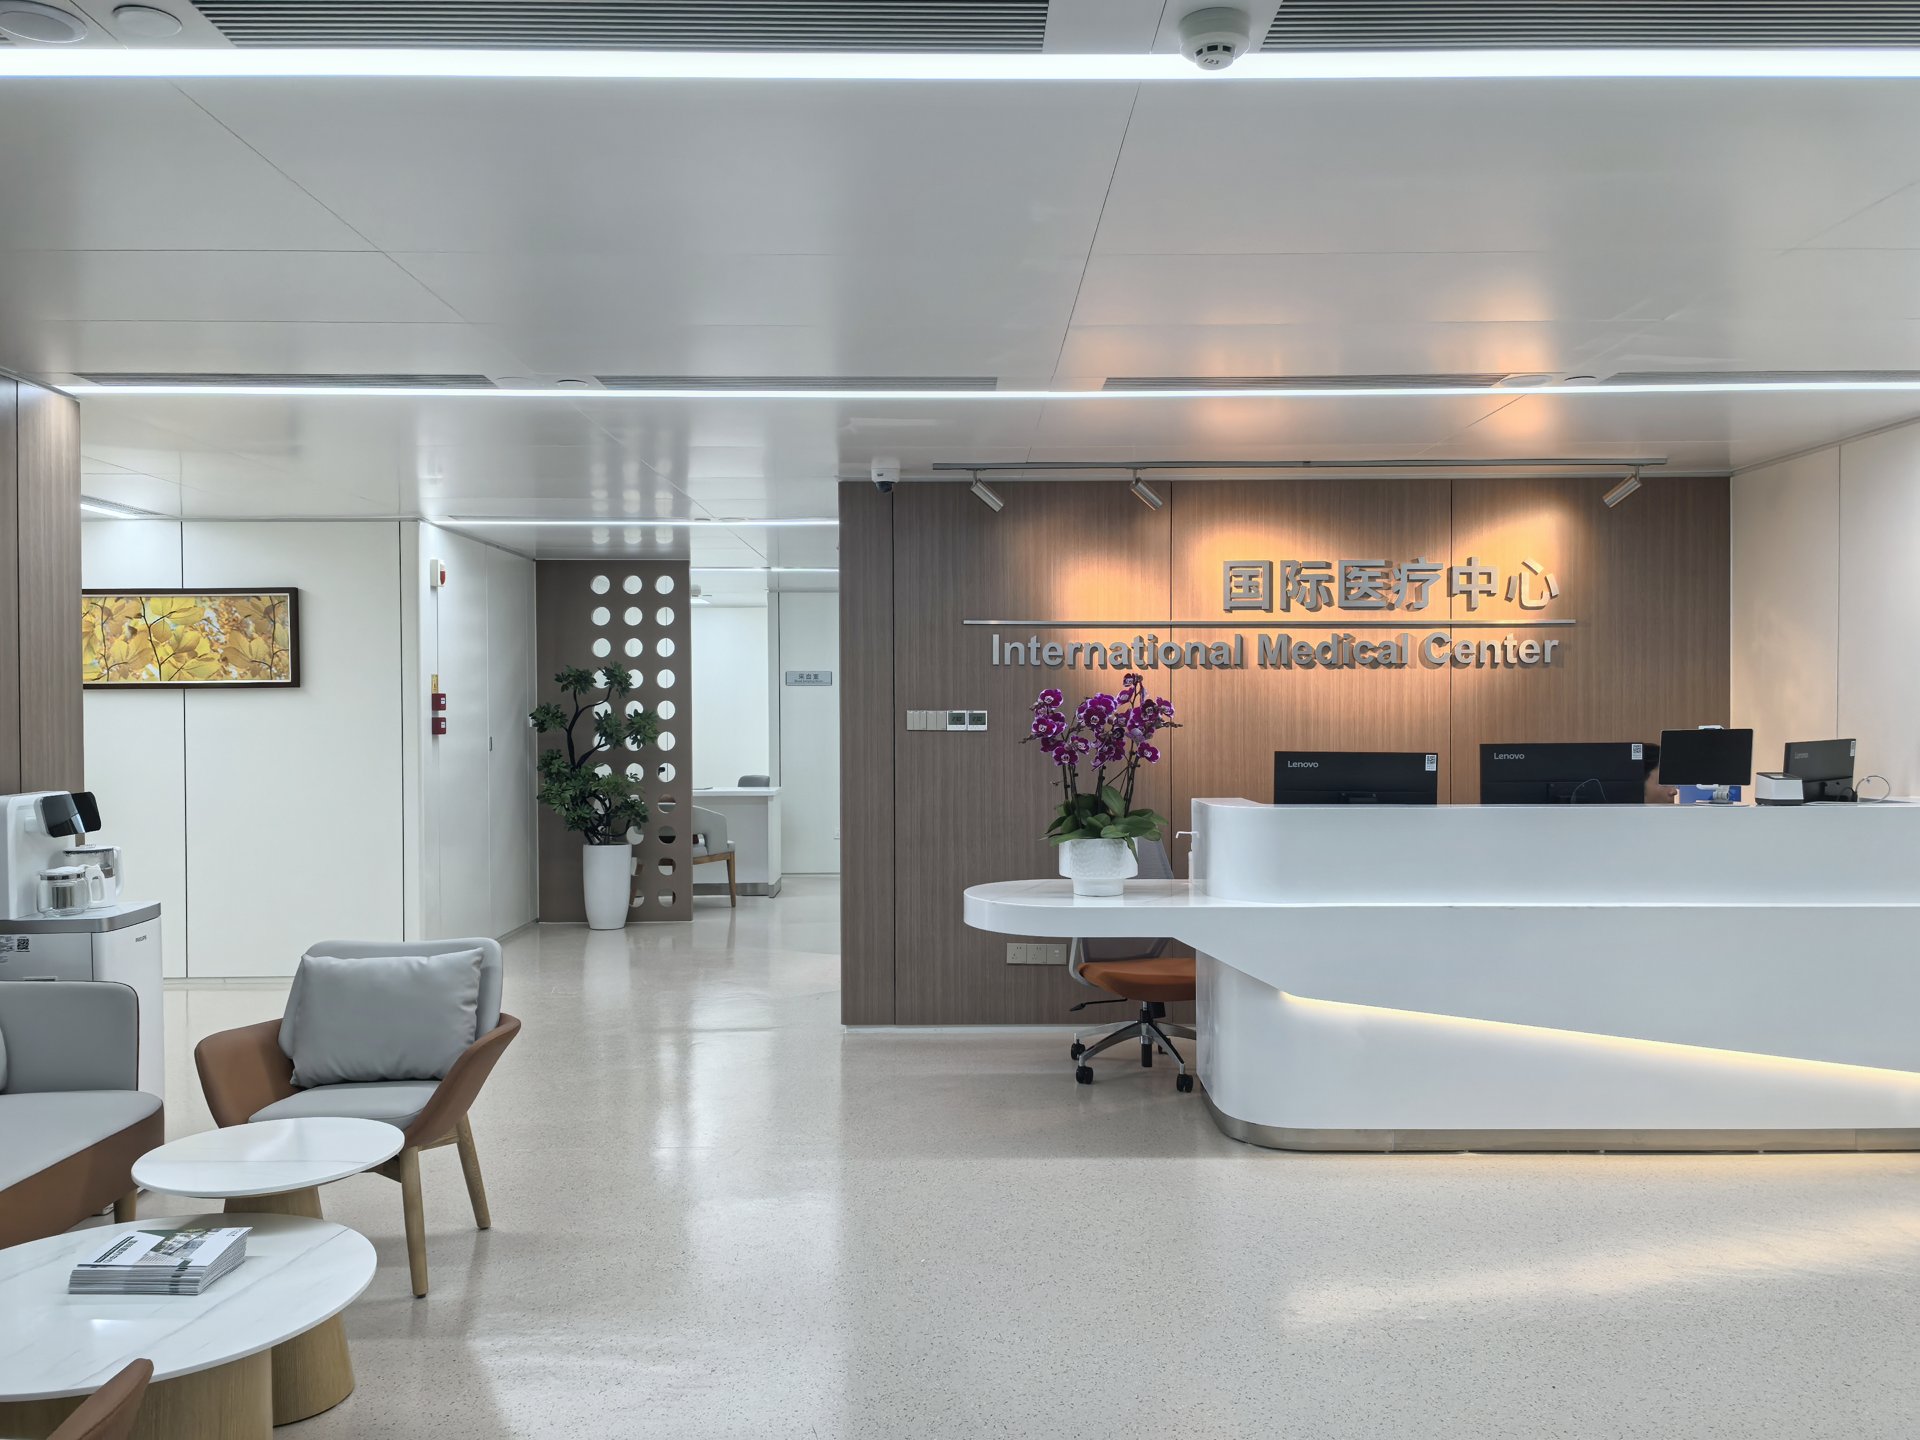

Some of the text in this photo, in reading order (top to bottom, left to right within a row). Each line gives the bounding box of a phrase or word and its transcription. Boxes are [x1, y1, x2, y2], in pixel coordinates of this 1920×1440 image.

[1222, 556, 1560, 612] 国际医疗中心
[992, 631, 1559, 668] International Medical Center
[1287, 760, 1319, 769] Lenovo
[1493, 752, 1525, 760] Lenovo
